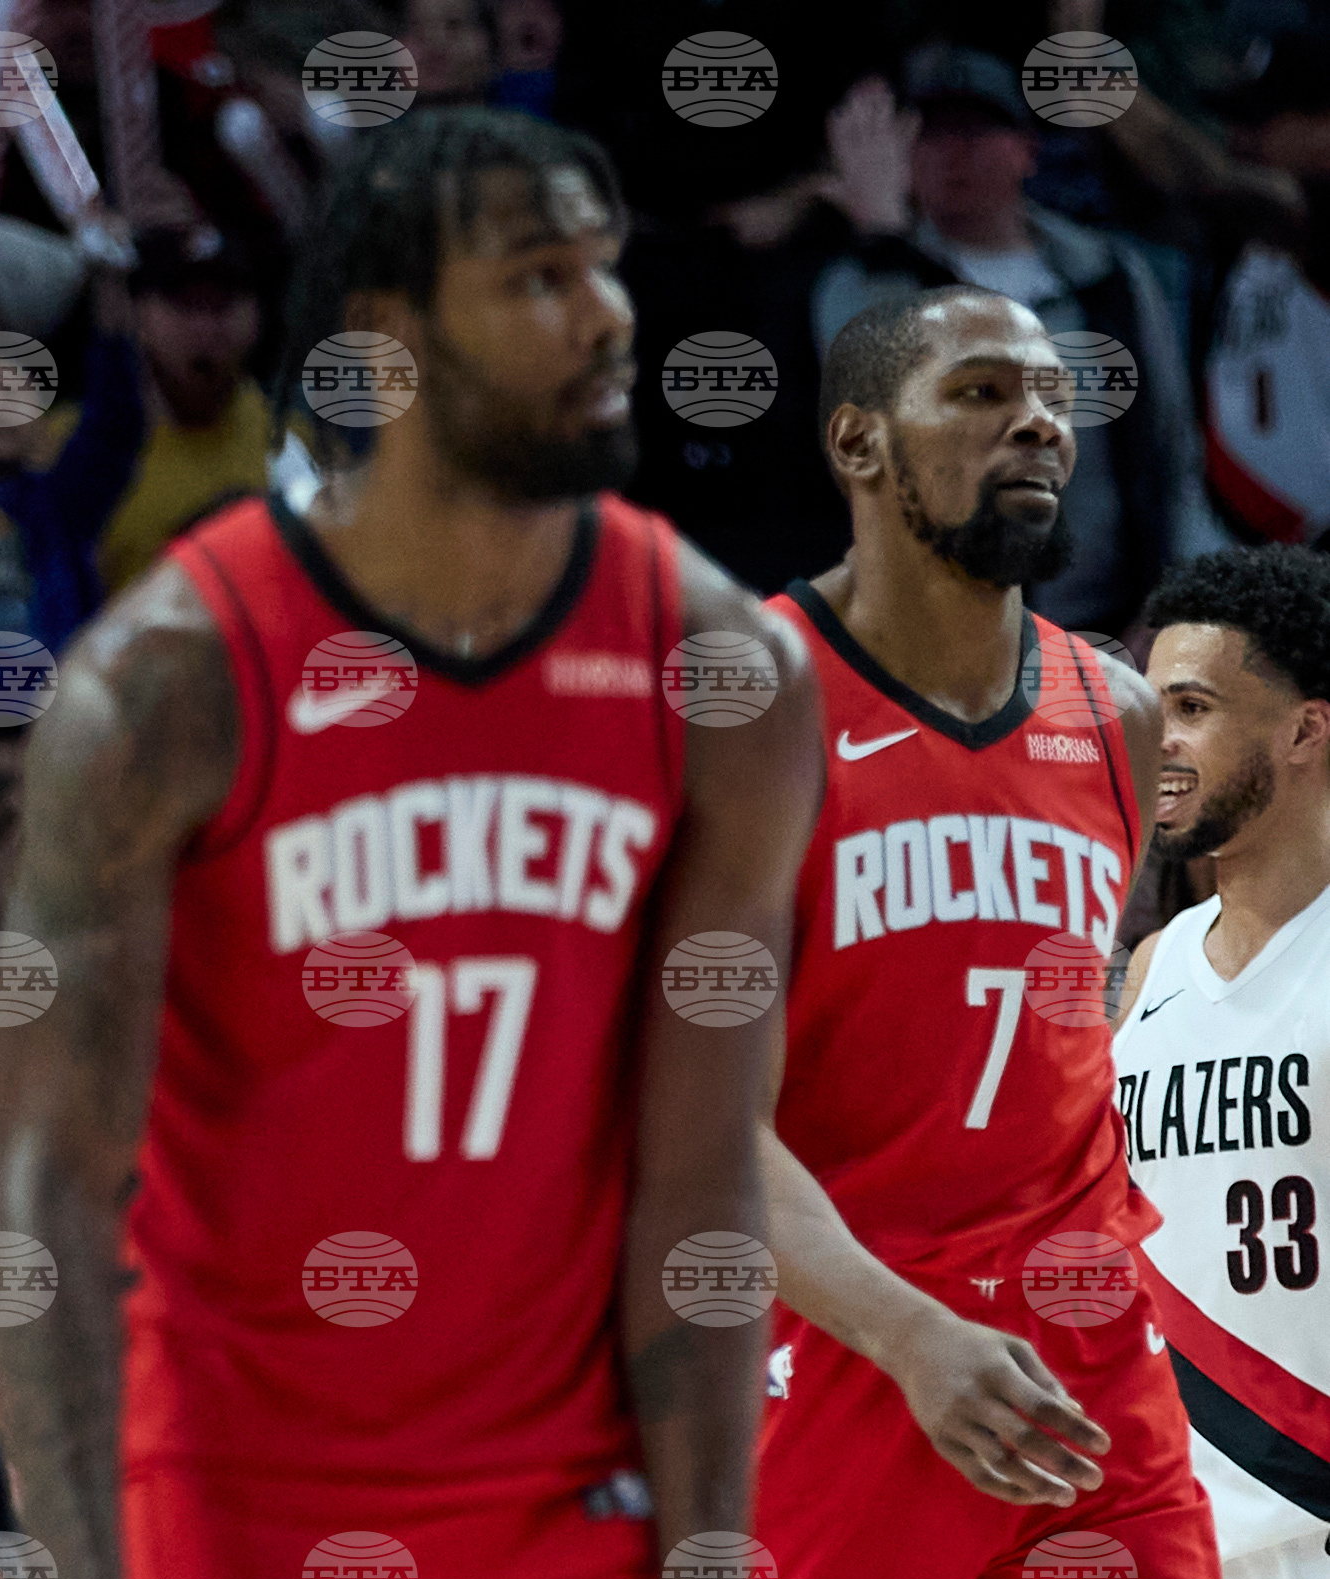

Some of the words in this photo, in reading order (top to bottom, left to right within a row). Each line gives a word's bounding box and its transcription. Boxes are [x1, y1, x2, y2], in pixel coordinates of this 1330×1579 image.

[1029, 745, 1100, 763] HERMANN
[264, 772, 656, 955] ROCKETS
[833, 813, 1121, 961] ROCKETS
[403, 955, 538, 1162] 17
[965, 967, 1027, 1130] 7
[1118, 1052, 1312, 1166] BLAZERS
[1226, 1175, 1320, 1295] 33
